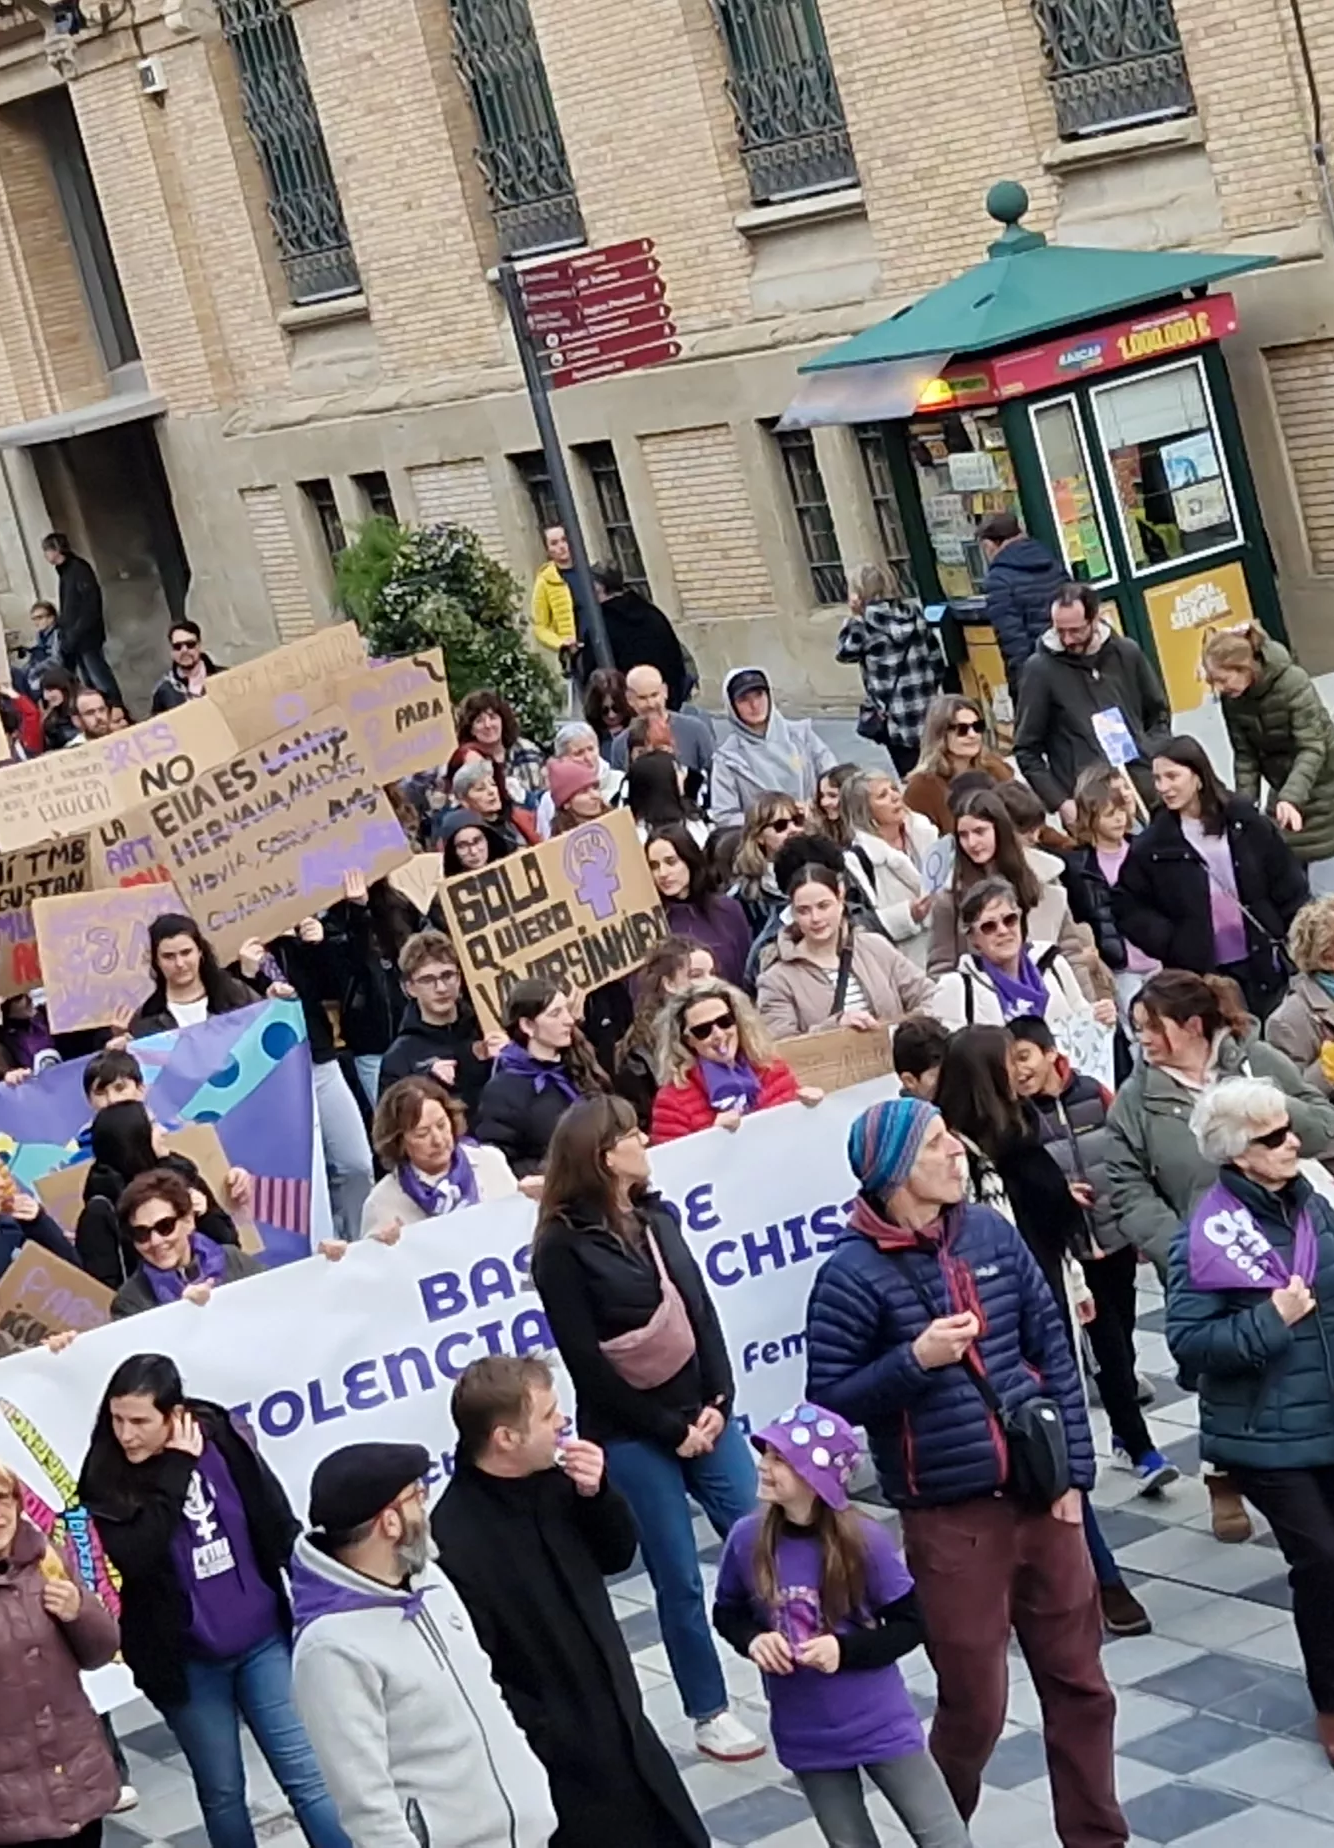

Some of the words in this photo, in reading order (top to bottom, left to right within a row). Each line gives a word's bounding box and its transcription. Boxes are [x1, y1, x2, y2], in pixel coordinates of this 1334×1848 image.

[140, 755, 195, 795] NO
[213, 759, 257, 801] ES
[447, 853, 548, 935] SOLO
